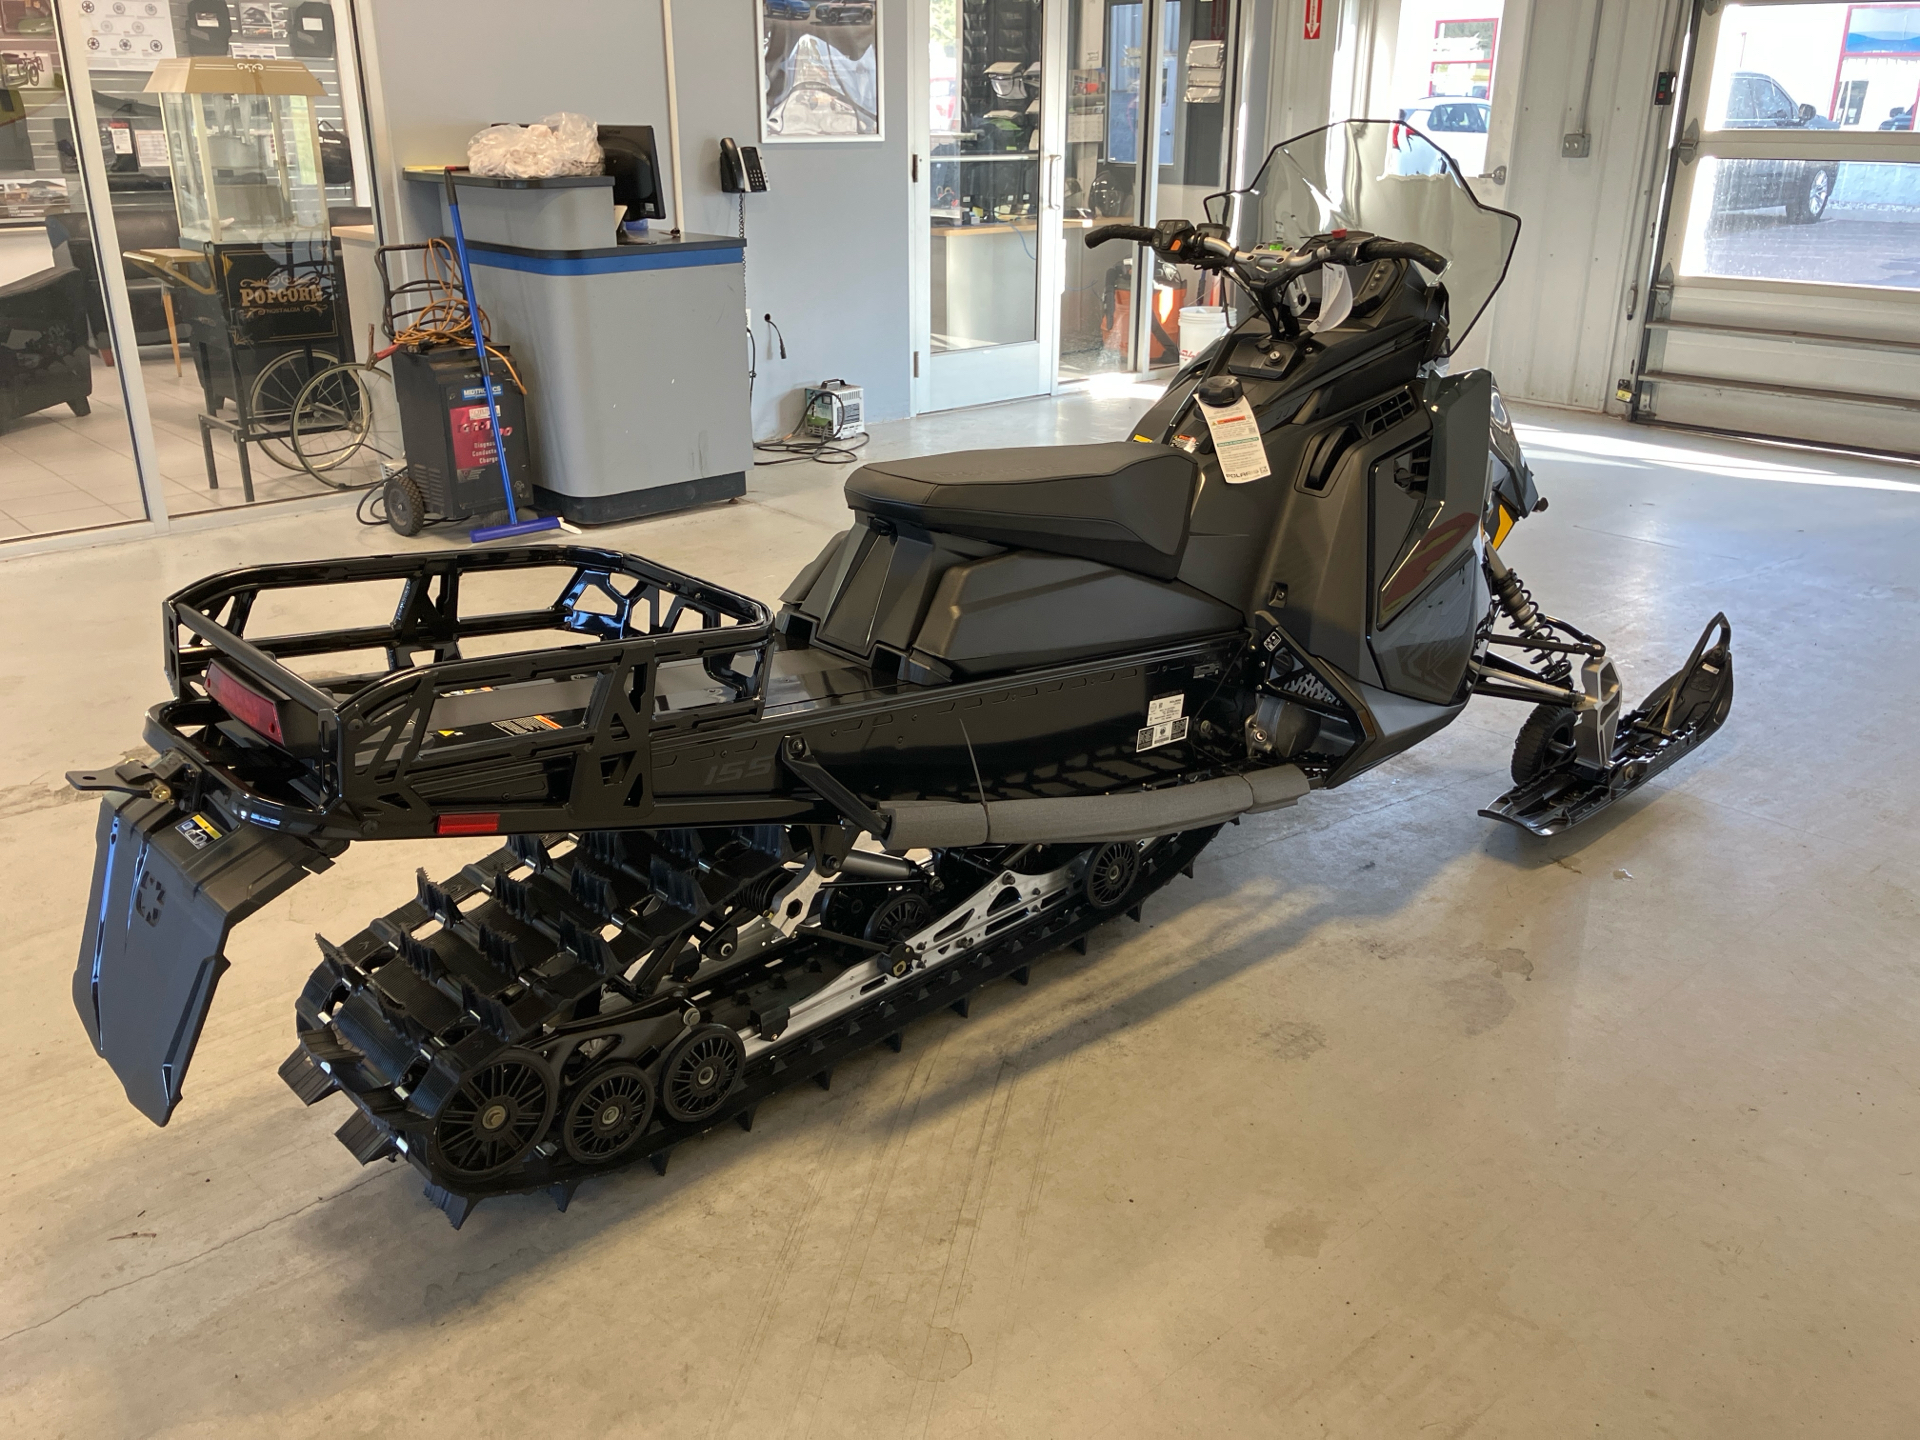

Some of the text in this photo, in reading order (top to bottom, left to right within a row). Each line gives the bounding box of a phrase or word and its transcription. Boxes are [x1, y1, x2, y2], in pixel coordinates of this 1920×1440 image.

[240, 285, 323, 306] POPCORN
[471, 447, 507, 457] Conductae
[479, 456, 498, 464] Charge
[704, 755, 775, 786] 155
